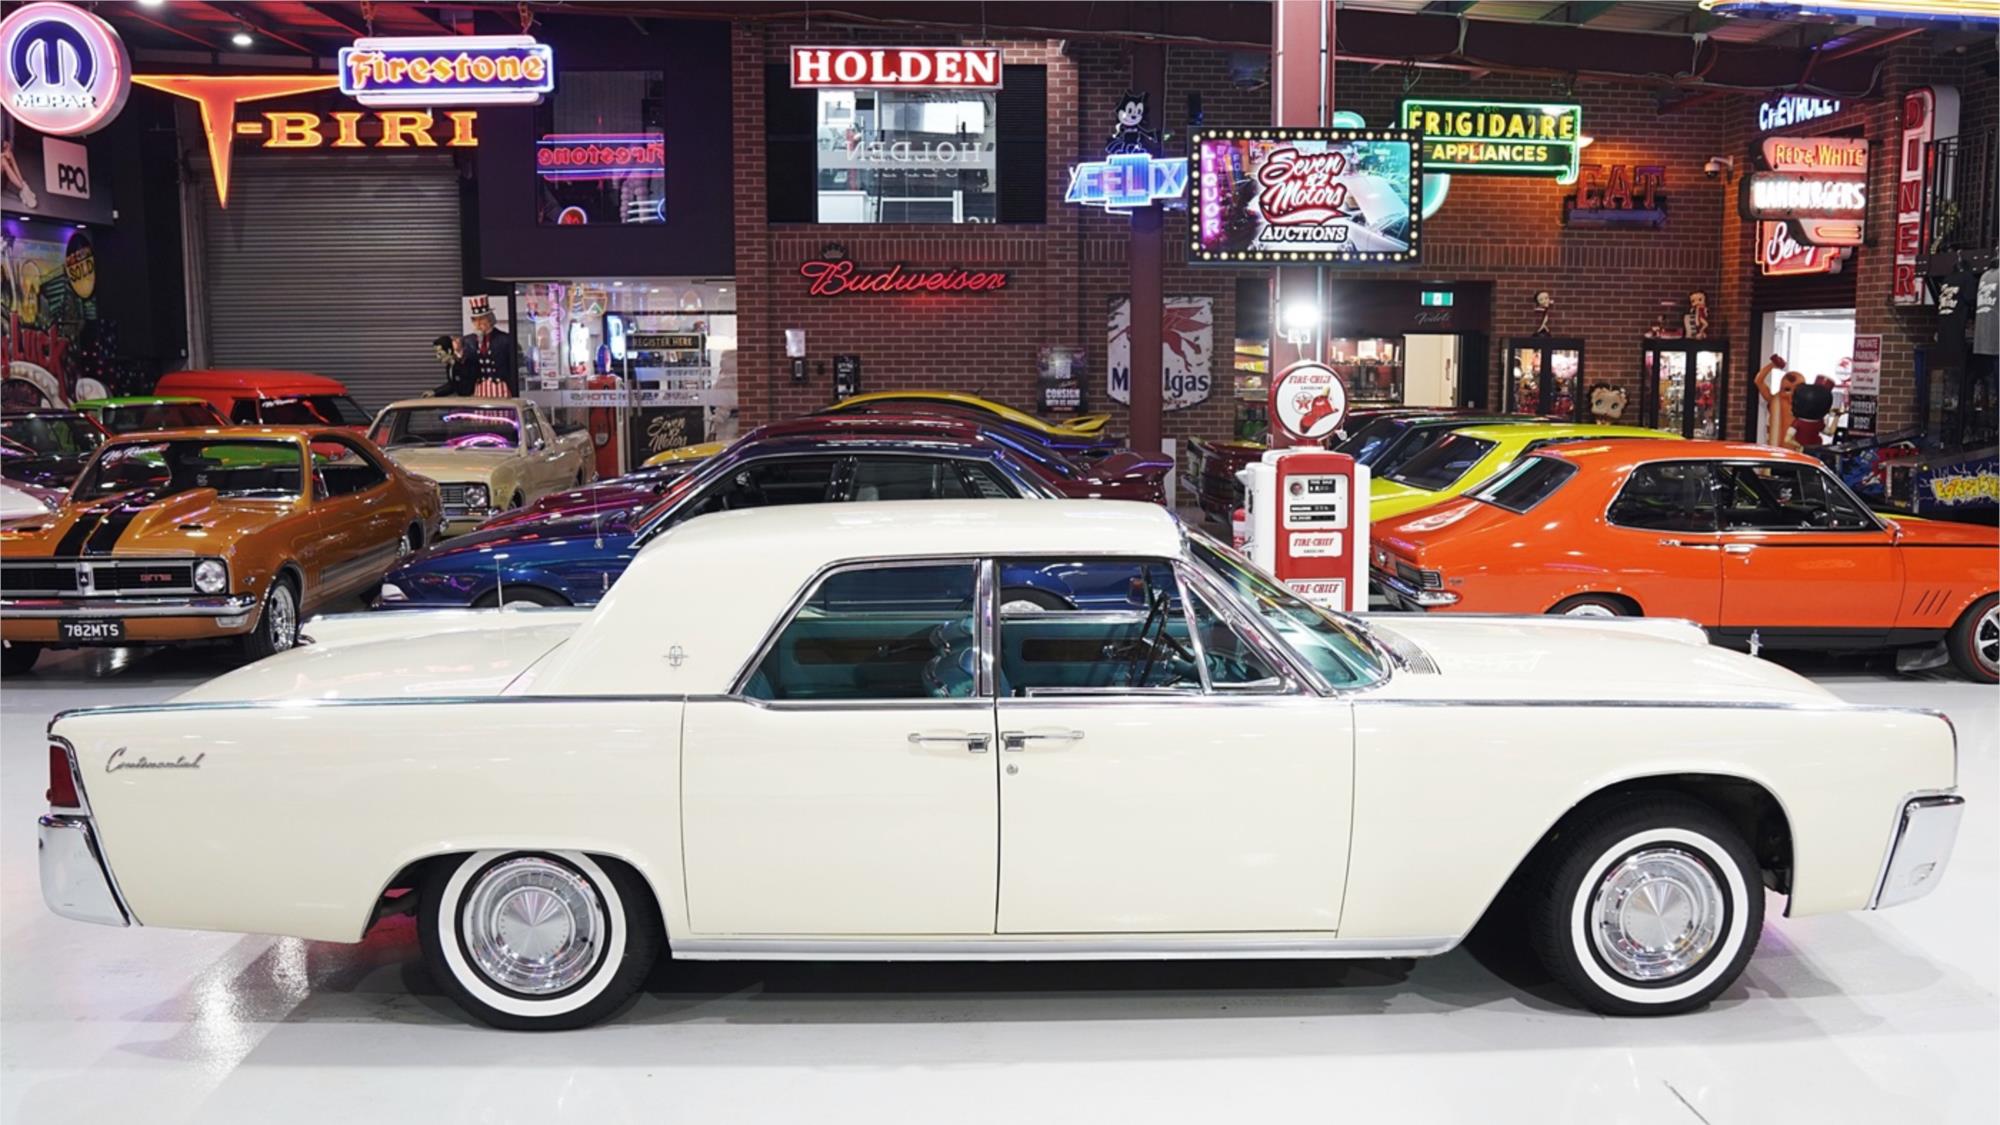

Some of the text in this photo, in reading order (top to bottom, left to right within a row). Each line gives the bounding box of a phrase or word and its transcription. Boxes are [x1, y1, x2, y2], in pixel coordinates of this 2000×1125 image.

[347, 51, 546, 90] Firestone
[797, 51, 996, 82] HOLDEN
[15, 94, 99, 109] MOPAR
[1409, 111, 1574, 139] FRIGIDAIRE
[1261, 150, 1344, 186] Seven
[1431, 144, 1548, 161] APPLIANCES
[1817, 145, 1864, 166] WHITE
[58, 163, 87, 193] PPQ
[1081, 163, 1181, 197] FELIX
[1202, 144, 1220, 238] LIQUOR
[1576, 164, 1665, 209] EAT
[1261, 180, 1344, 214] Motors
[1896, 97, 1924, 296] DINER
[1261, 226, 1346, 241] AUCTIONS
[801, 260, 1006, 295] Budweiser
[1045, 388, 1080, 399] CONSIGN
[64, 624, 119, 637] 782MTS
